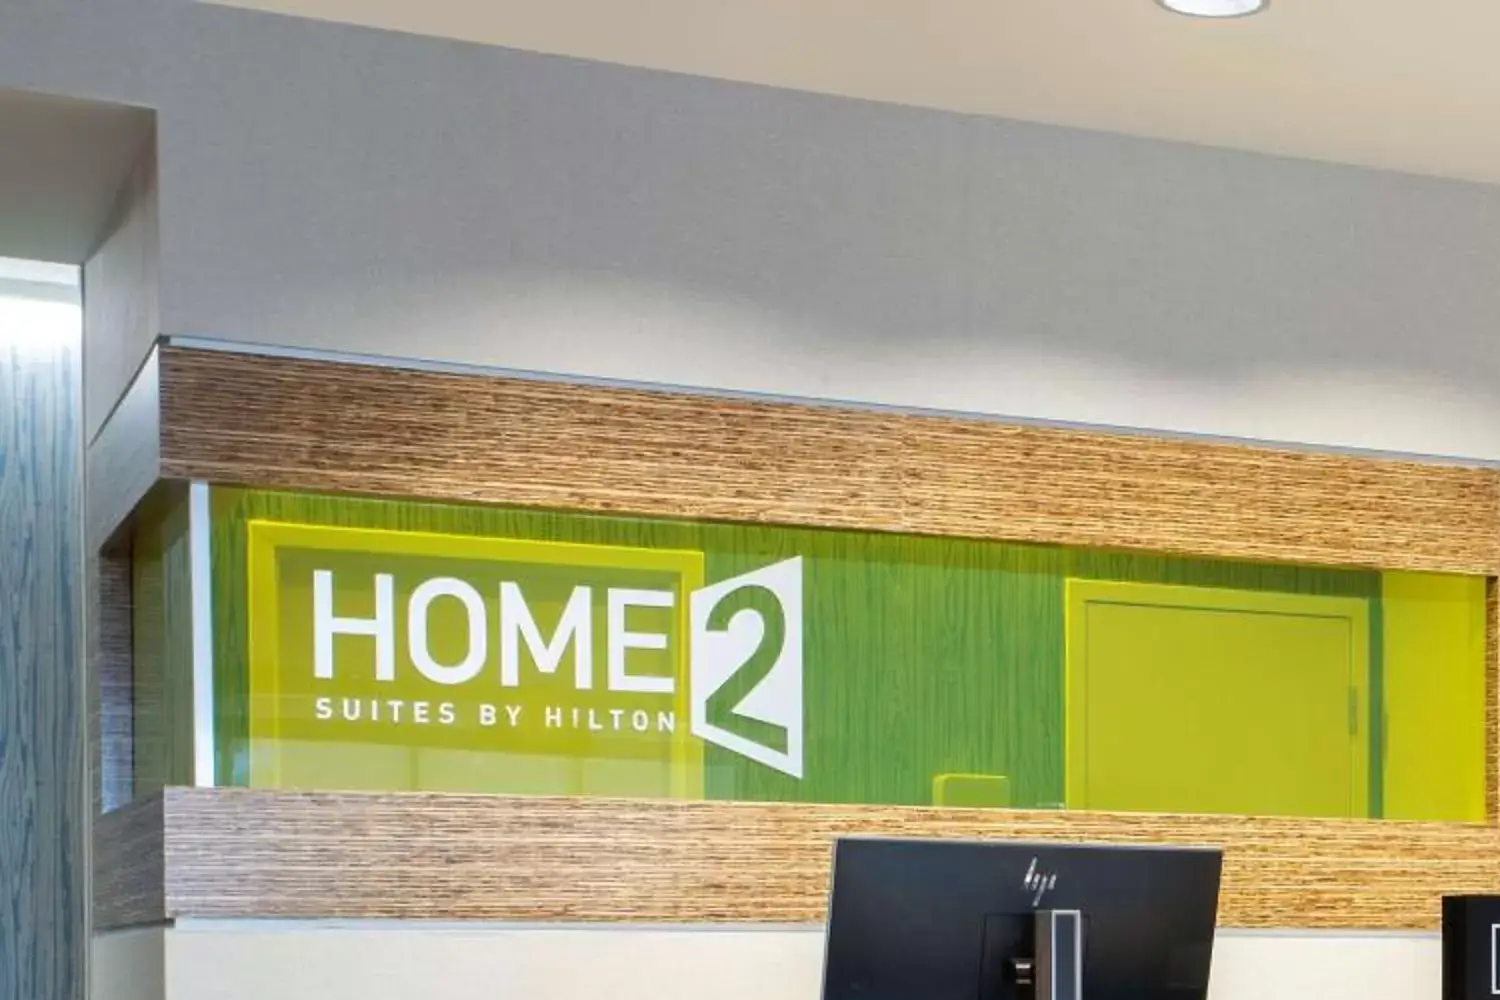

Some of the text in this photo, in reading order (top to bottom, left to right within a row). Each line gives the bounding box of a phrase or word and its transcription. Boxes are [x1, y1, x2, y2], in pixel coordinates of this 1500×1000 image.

[312, 568, 676, 694] HOME
[315, 697, 676, 734] SUITES BY HILTON
